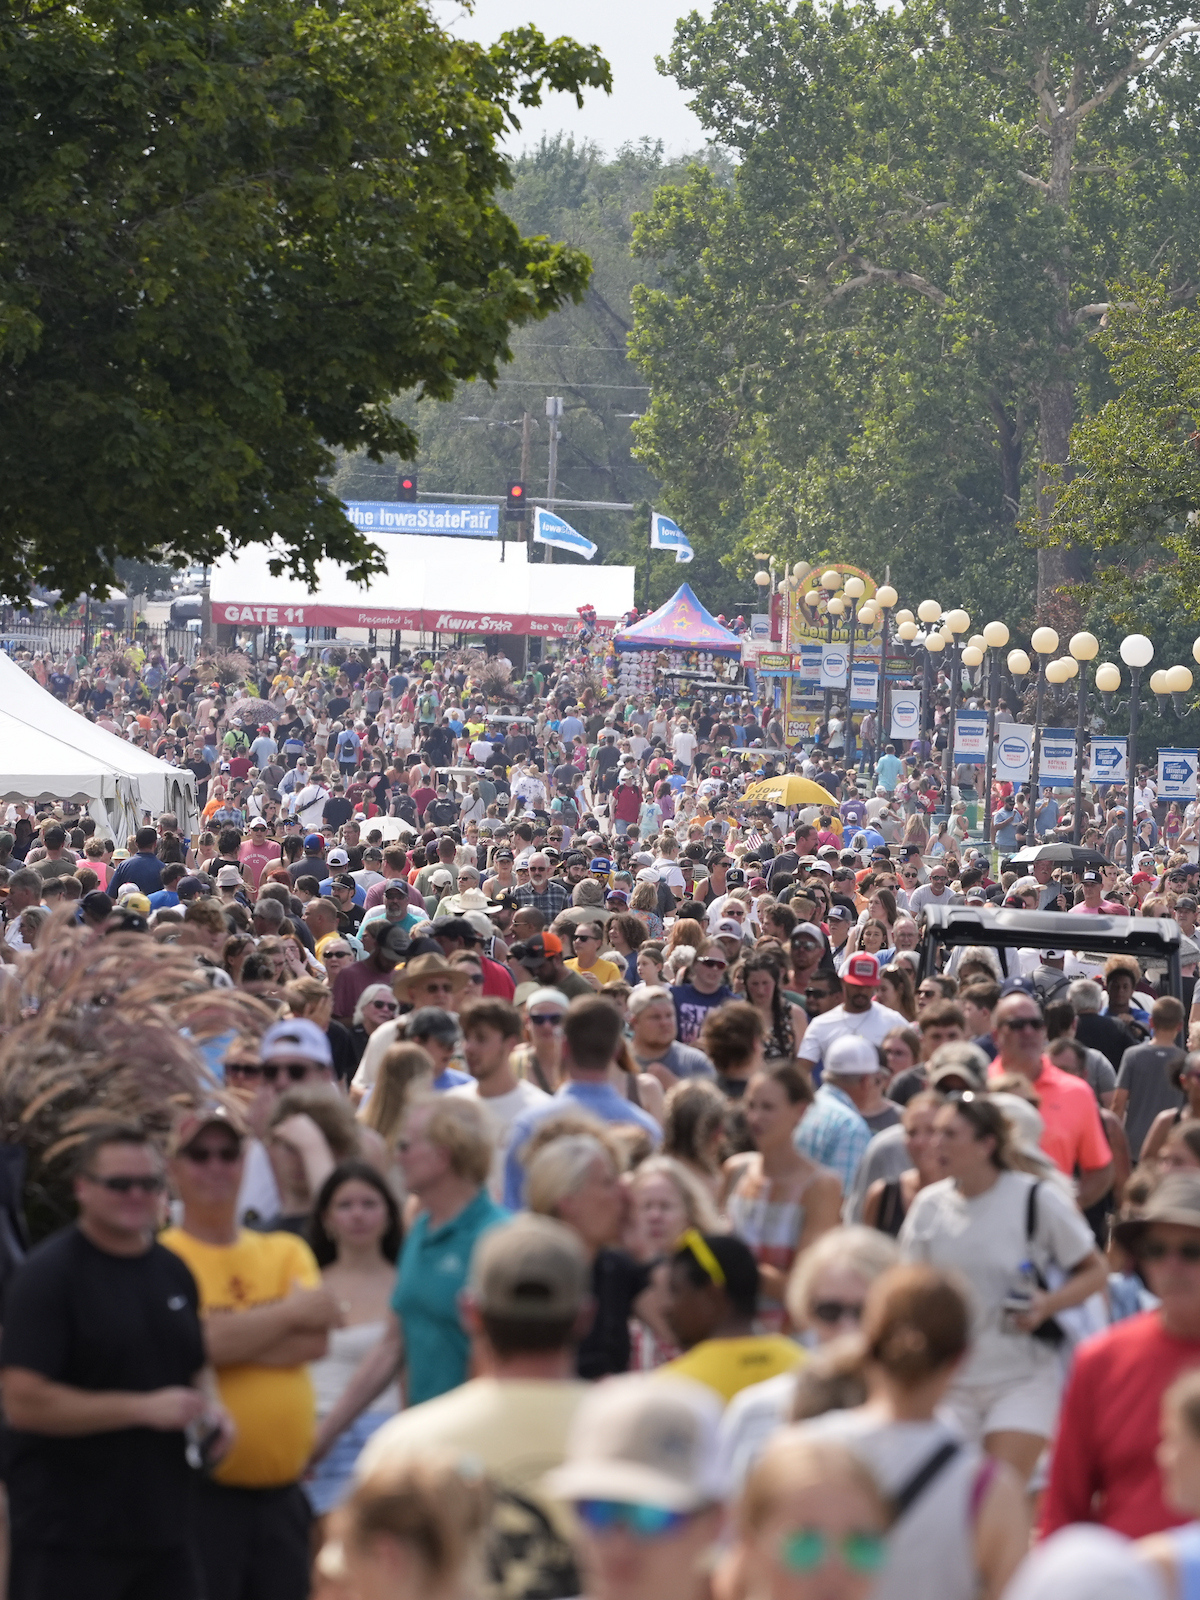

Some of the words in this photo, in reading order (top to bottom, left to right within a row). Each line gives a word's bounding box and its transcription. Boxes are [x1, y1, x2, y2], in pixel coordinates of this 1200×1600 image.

[348, 508, 374, 526] the
[380, 508, 491, 530] IowaStateFair
[224, 606, 279, 623] GATE
[284, 608, 305, 623] 11
[358, 613, 400, 625] Presented
[530, 620, 549, 632] See
[800, 622, 876, 643] Lemonde
[789, 721, 810, 730] FOOT
